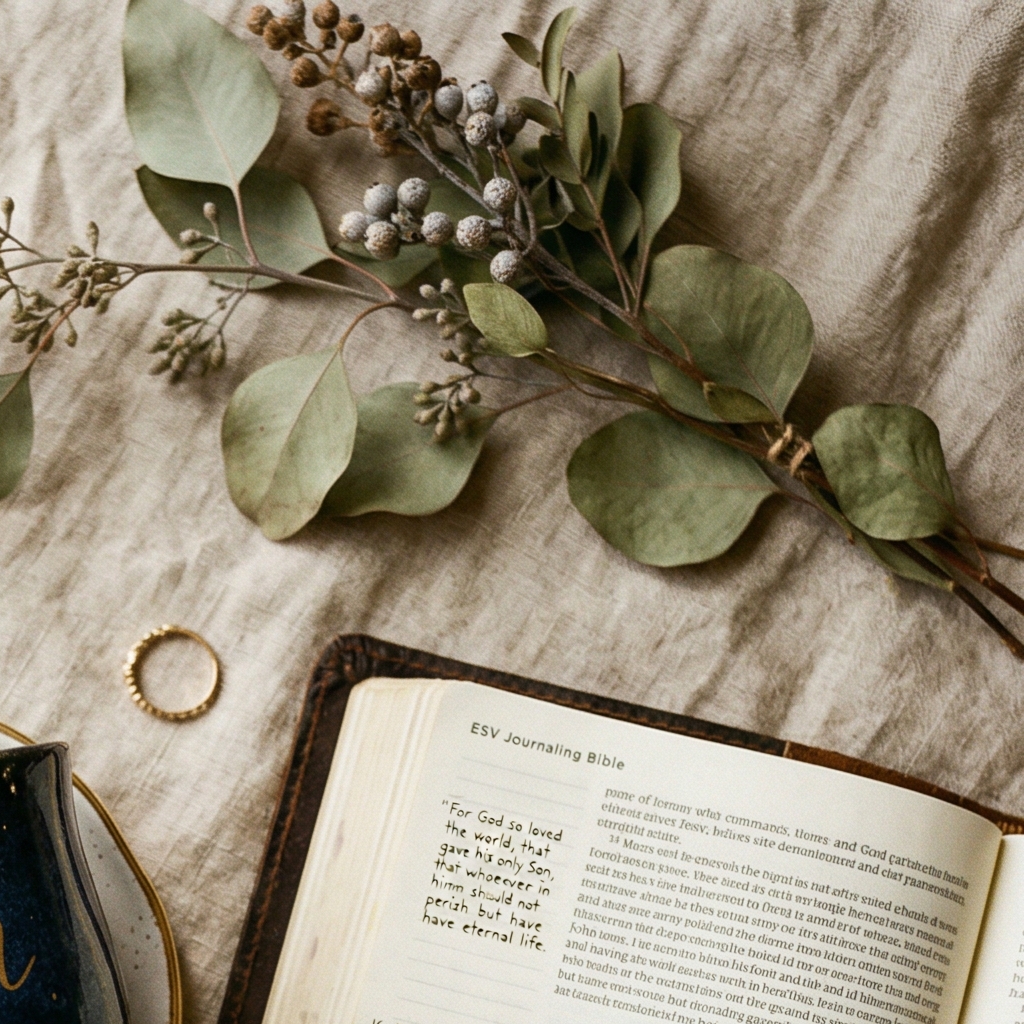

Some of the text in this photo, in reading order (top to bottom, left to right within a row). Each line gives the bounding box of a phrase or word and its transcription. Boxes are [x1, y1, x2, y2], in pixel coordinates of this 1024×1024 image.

[470, 722, 625, 770] ESV Journaling Bible
[446, 820, 550, 858] the world, that
[478, 810, 504, 827] God
[508, 820, 522, 832] so
[528, 822, 562, 842] loved
[438, 843, 469, 858] gave
[498, 856, 523, 876] only
[528, 861, 554, 881] Son,
[539, 880, 550, 896] in
[478, 904, 502, 920] but
[510, 912, 542, 932] have
[518, 900, 540, 912] not
[423, 910, 546, 952] have eternal life.
